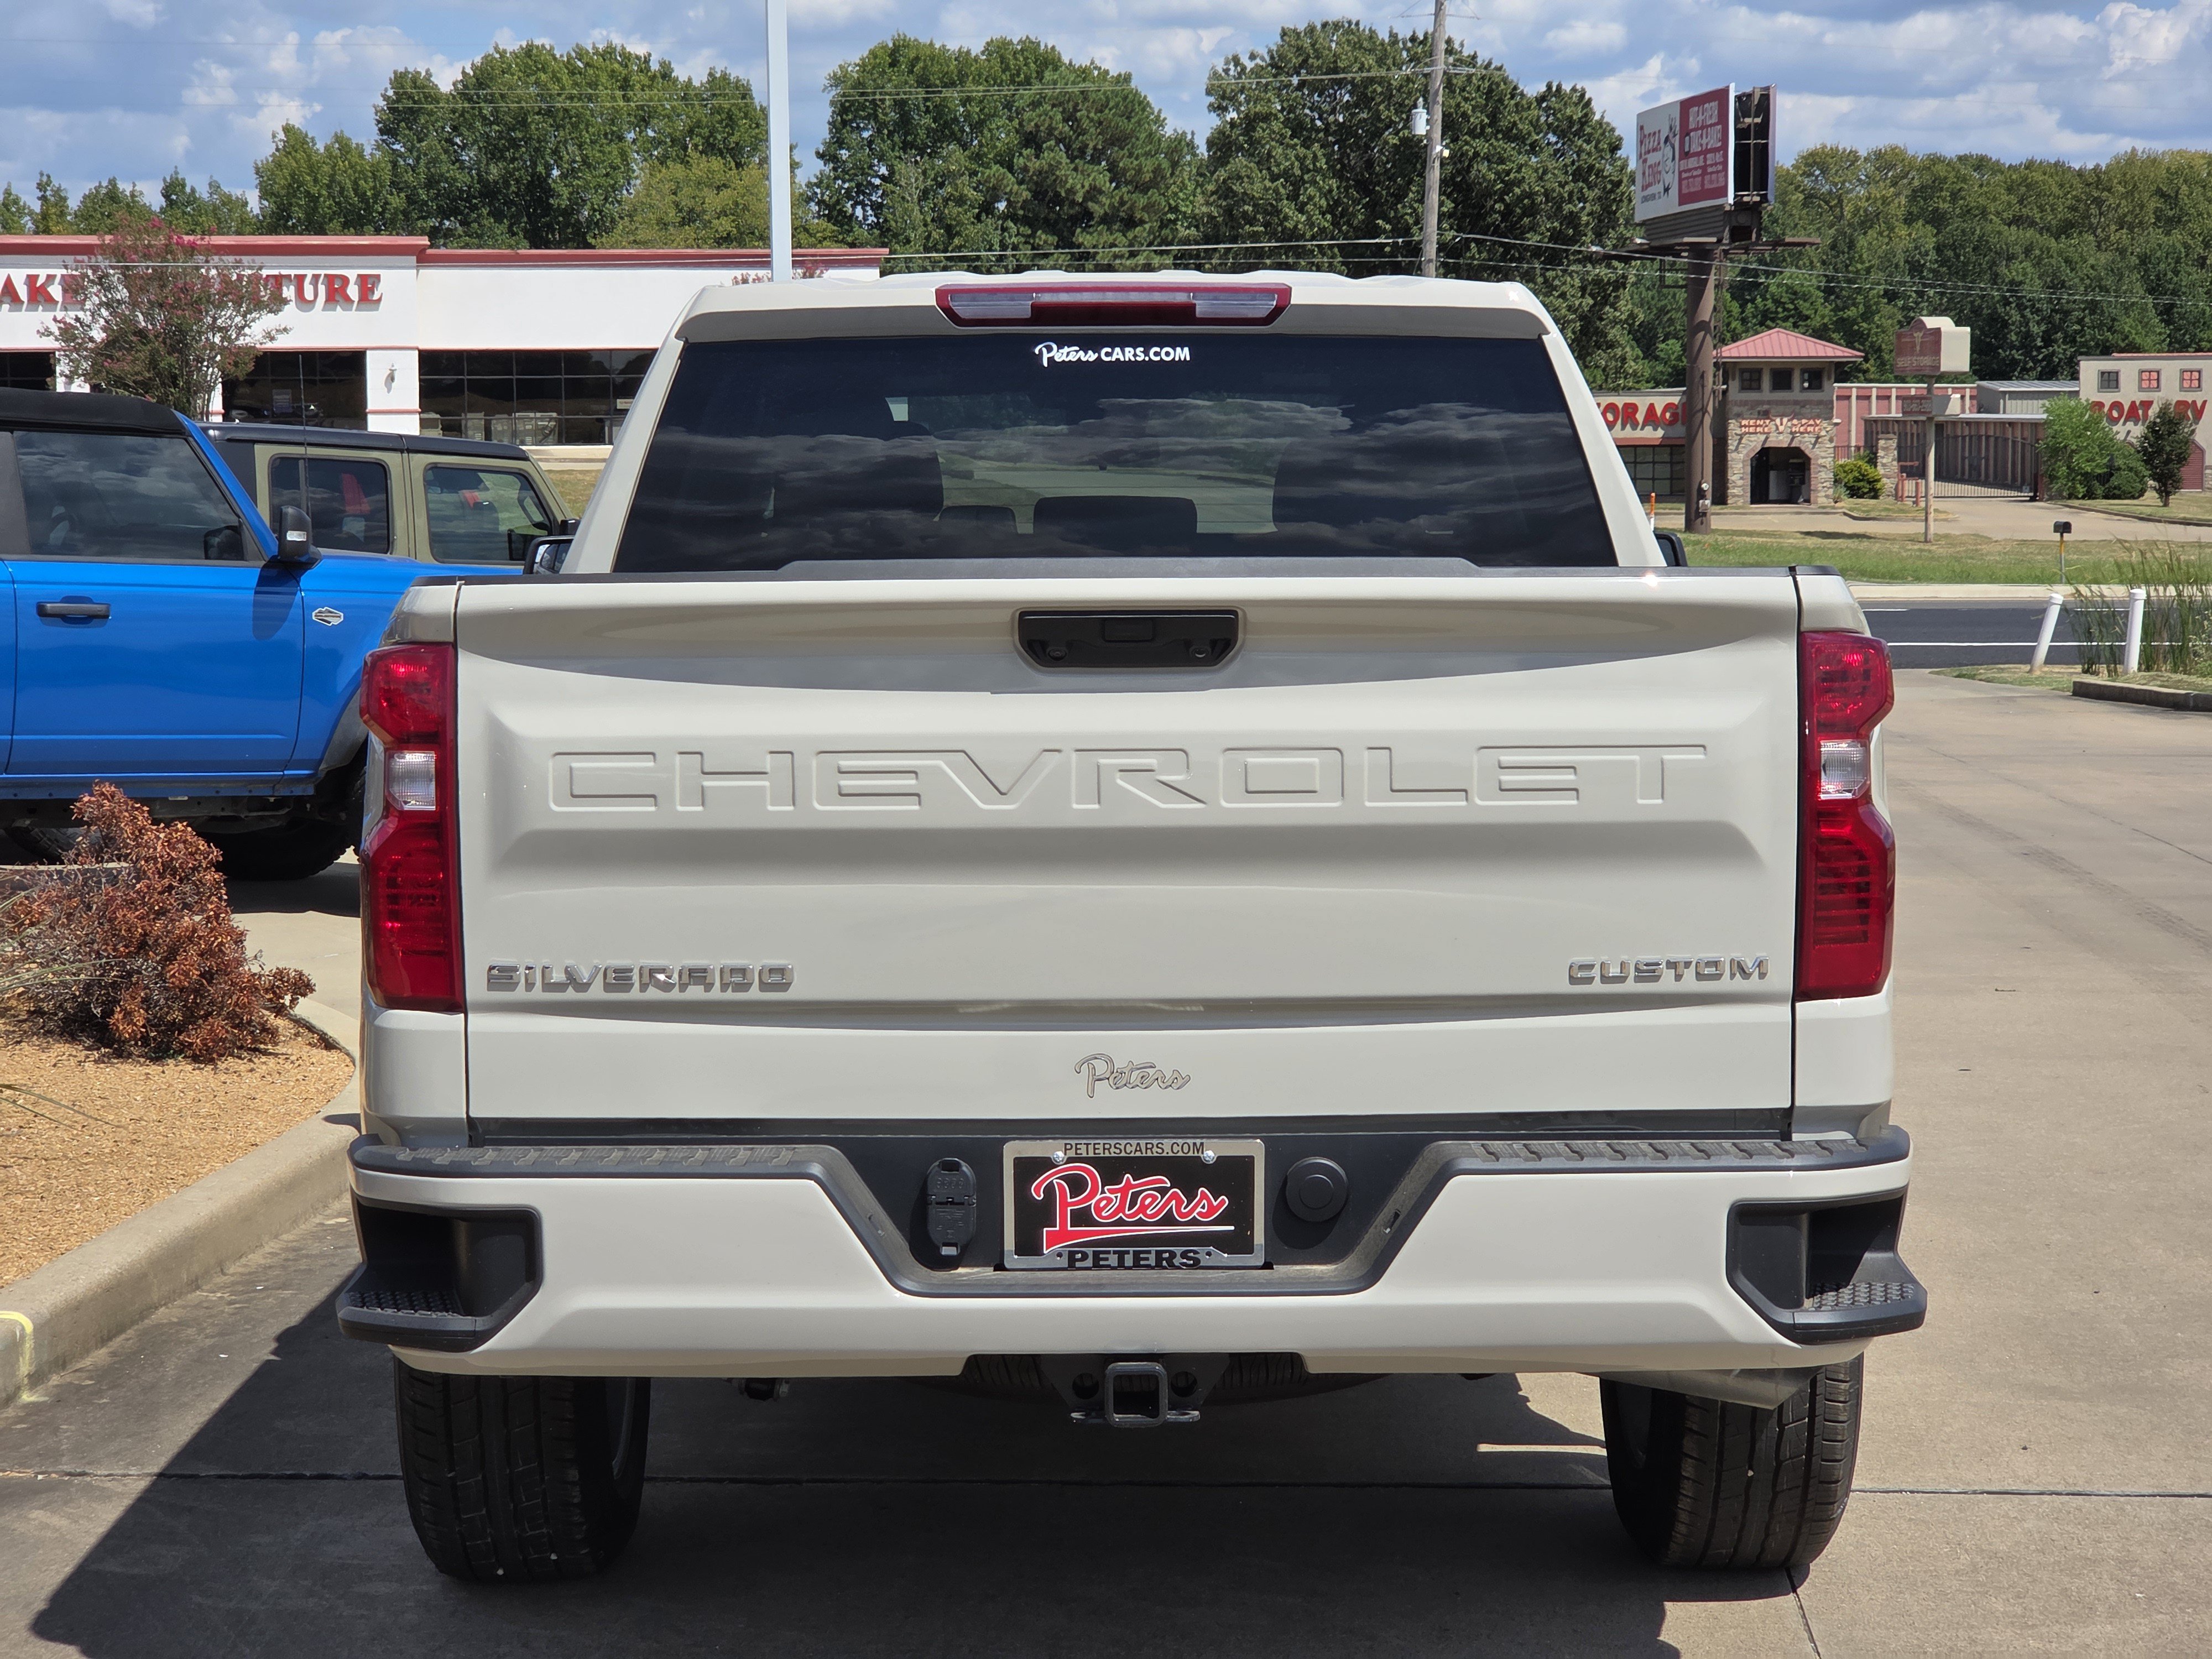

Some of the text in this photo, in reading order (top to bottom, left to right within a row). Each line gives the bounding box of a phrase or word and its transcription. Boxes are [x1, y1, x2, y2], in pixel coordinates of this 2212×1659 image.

[1035, 341, 1190, 367] Peters CARS.COM
[1596, 402, 1687, 426] ORAG
[547, 744, 1707, 811] CHEVROLET
[487, 963, 795, 992] SILVERADO
[1568, 956, 1770, 986] CUSTOM
[1074, 1053, 1191, 1098] Peters
[1063, 1141, 1205, 1156] PETERSCARS.COM
[1031, 1163, 1234, 1253] Peters
[1067, 1249, 1201, 1269] PETERS
